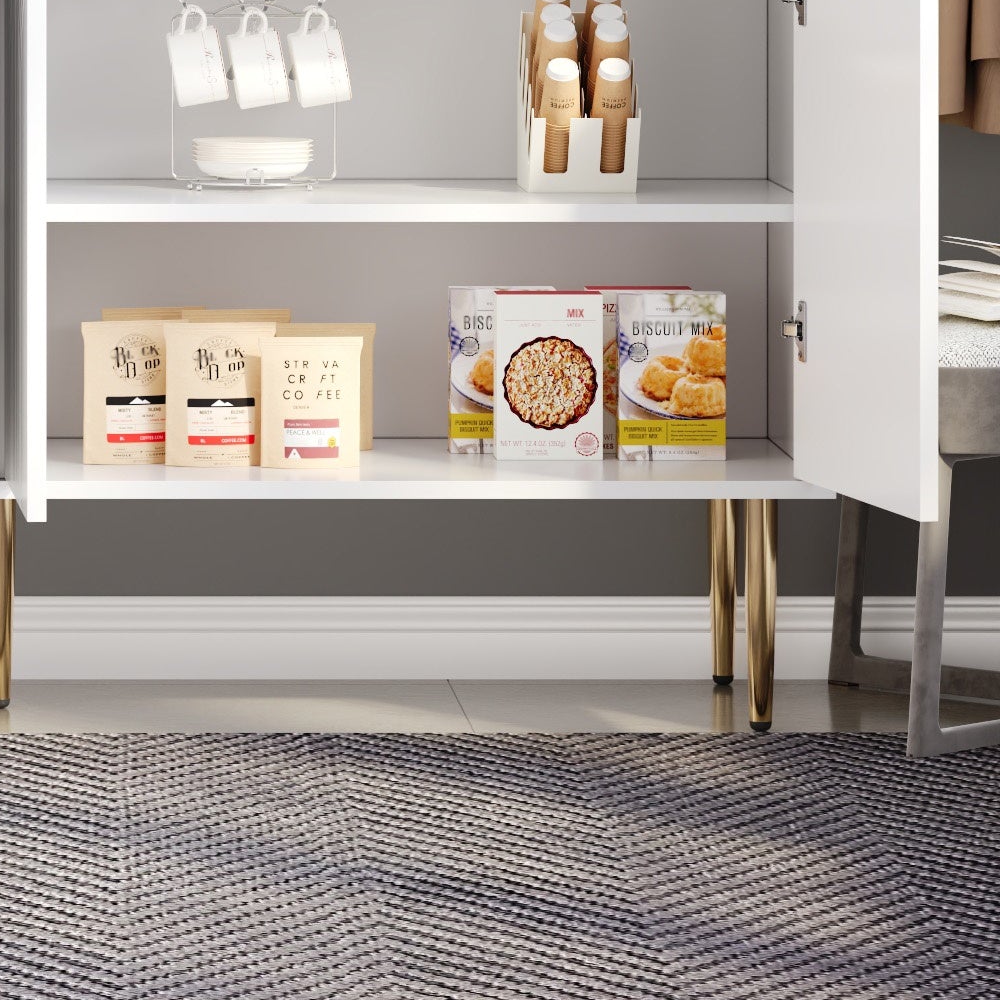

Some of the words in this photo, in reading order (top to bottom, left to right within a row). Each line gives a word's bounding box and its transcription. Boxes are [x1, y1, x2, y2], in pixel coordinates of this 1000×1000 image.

[550, 101, 575, 109] COFFEE
[601, 101, 627, 109] COFFEE
[566, 308, 585, 318] MIX
[603, 303, 617, 313] PIZ
[463, 315, 493, 330] BISC
[632, 321, 683, 336] BISCUIT
[691, 321, 714, 336] MIX
